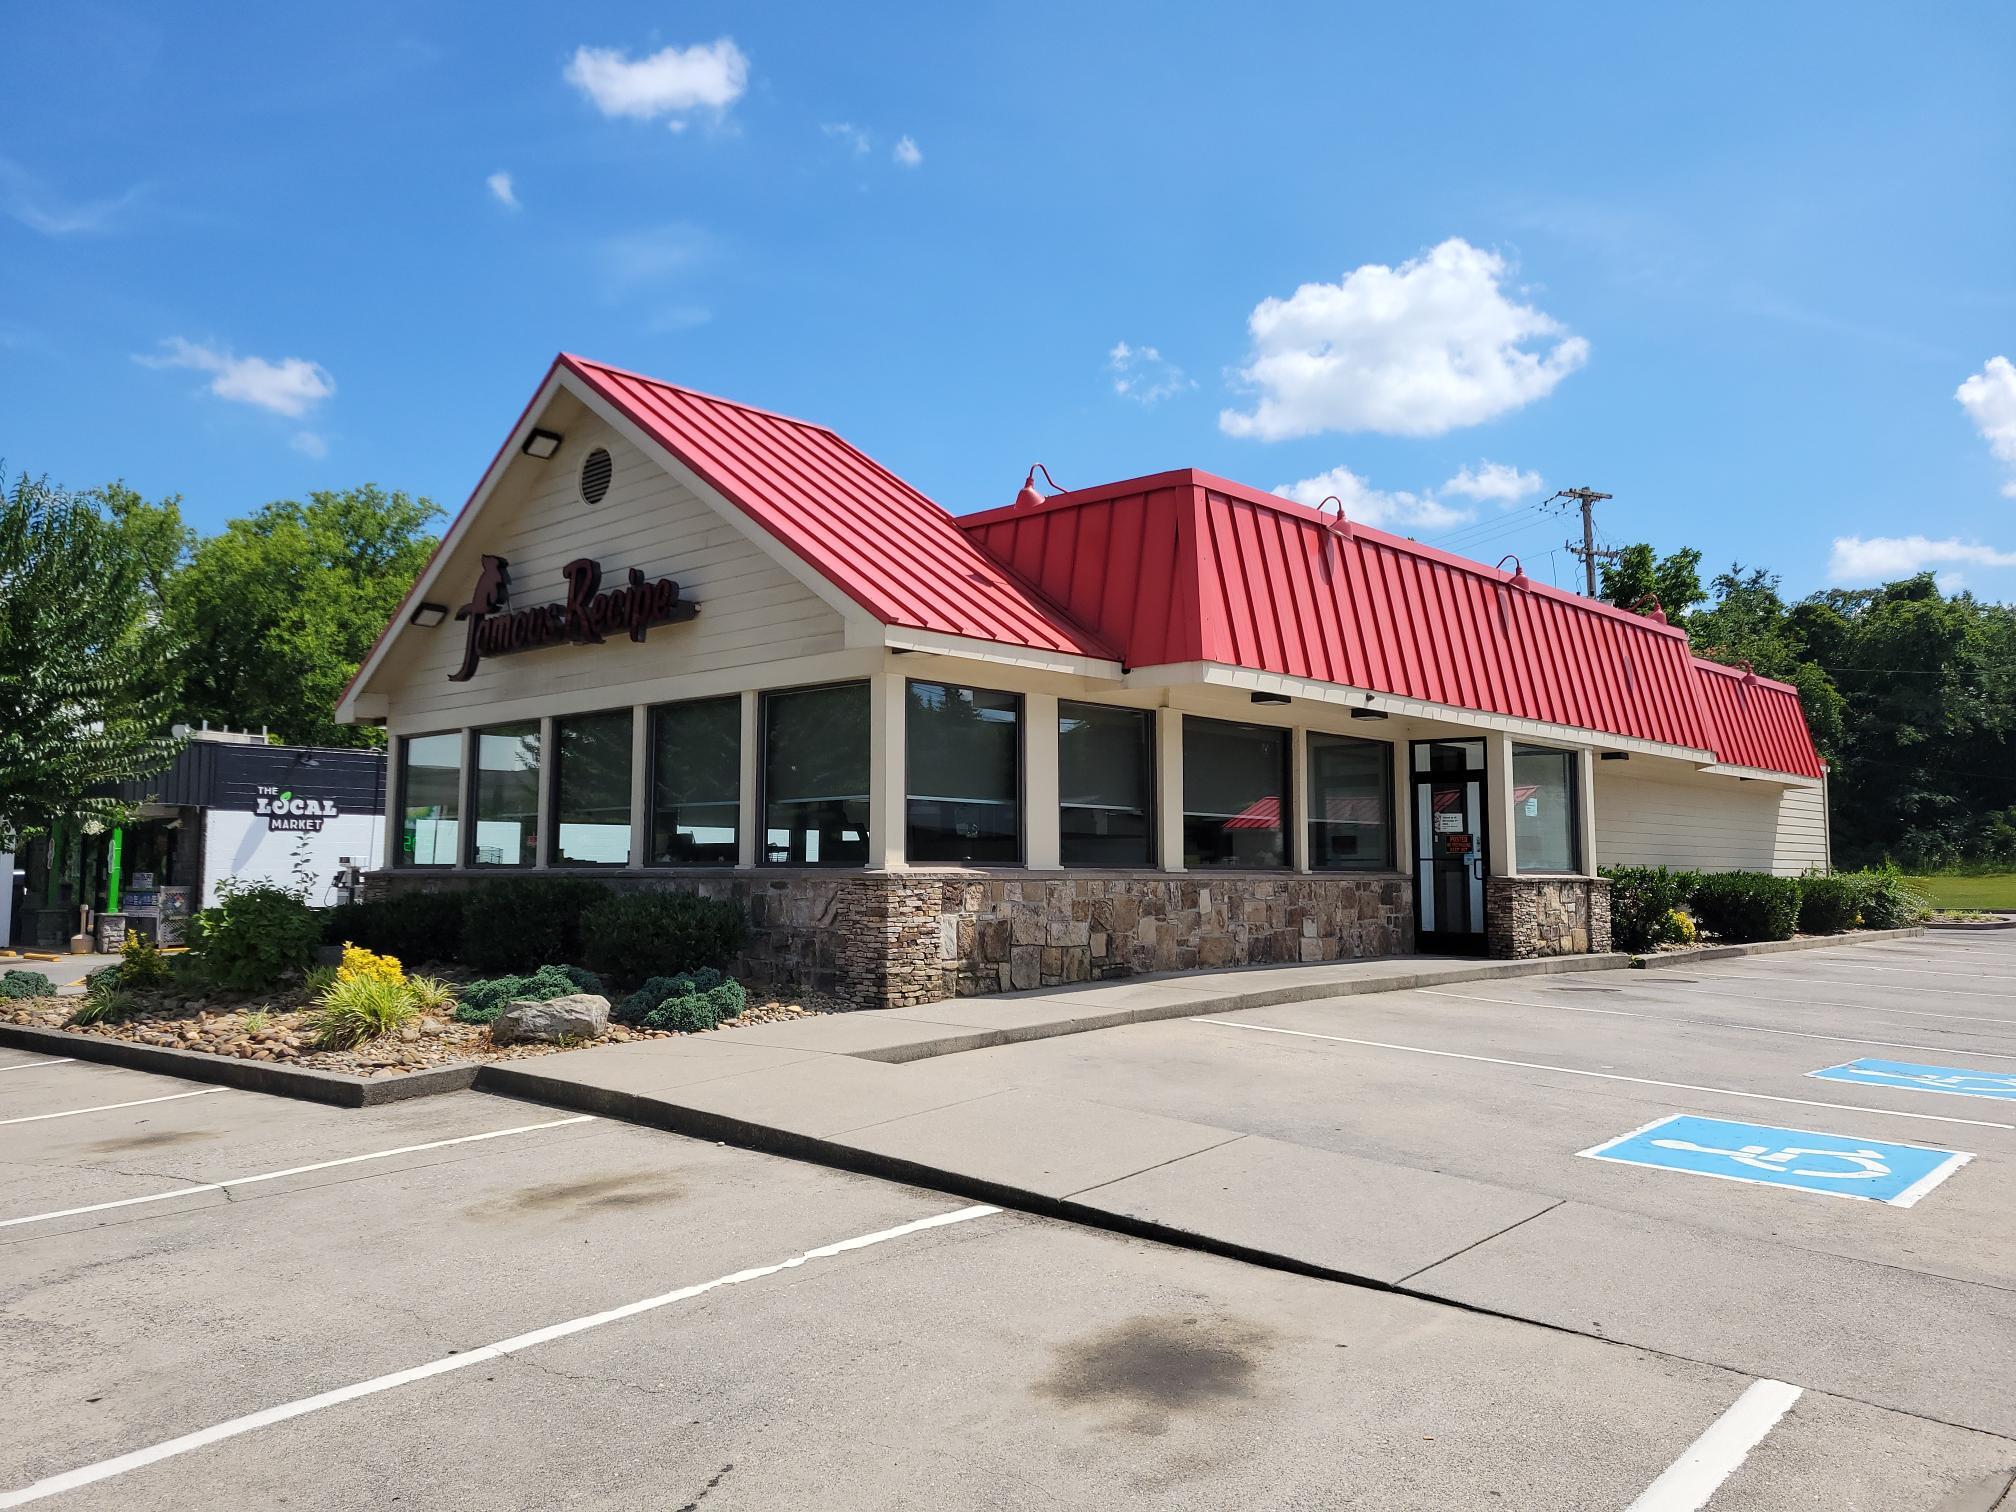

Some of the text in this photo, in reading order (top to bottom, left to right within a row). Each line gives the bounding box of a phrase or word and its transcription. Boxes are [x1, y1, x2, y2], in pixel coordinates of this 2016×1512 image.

[563, 558, 679, 643] Recipe
[257, 786, 279, 795] THE
[256, 798, 338, 815] LOCAL
[271, 819, 323, 830] MARKET
